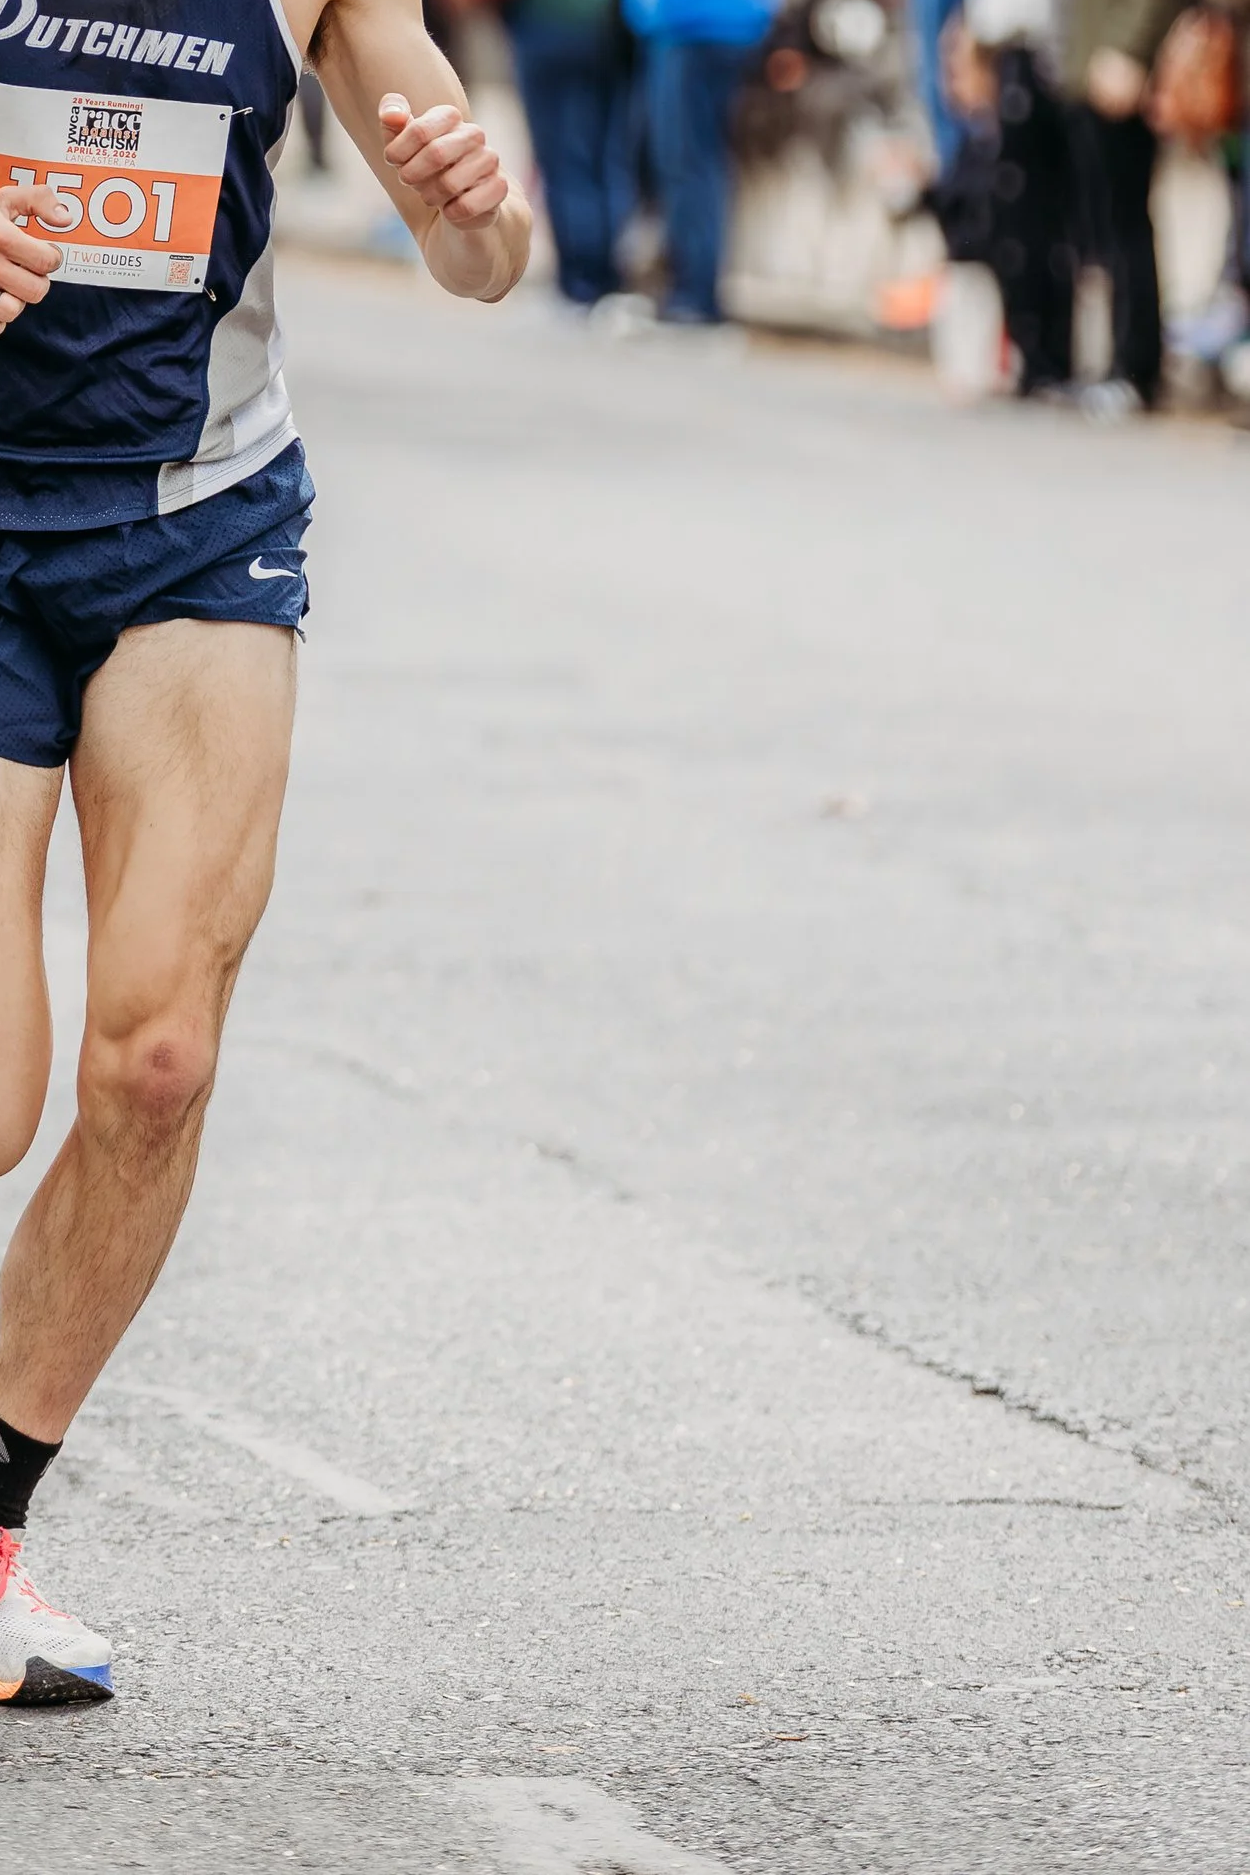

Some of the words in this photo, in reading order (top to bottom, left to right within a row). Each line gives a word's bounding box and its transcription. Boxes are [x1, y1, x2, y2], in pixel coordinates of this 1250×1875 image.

[72, 97, 83, 105] 28
[85, 98, 105, 106] Years
[107, 100, 144, 111] Running!
[67, 106, 80, 145] ywca
[83, 108, 142, 132] race
[81, 126, 137, 140] against
[78, 130, 139, 152] RACISM
[66, 146, 93, 155] APRIL
[95, 148, 110, 158] 25,
[112, 150, 137, 159] 2026
[65, 154, 122, 166] LANCASTER,
[124, 159, 136, 167] PA
[9, 166, 177, 242] 1501
[69, 267, 105, 275] PAINTING
[108, 270, 141, 278] COMPANY
